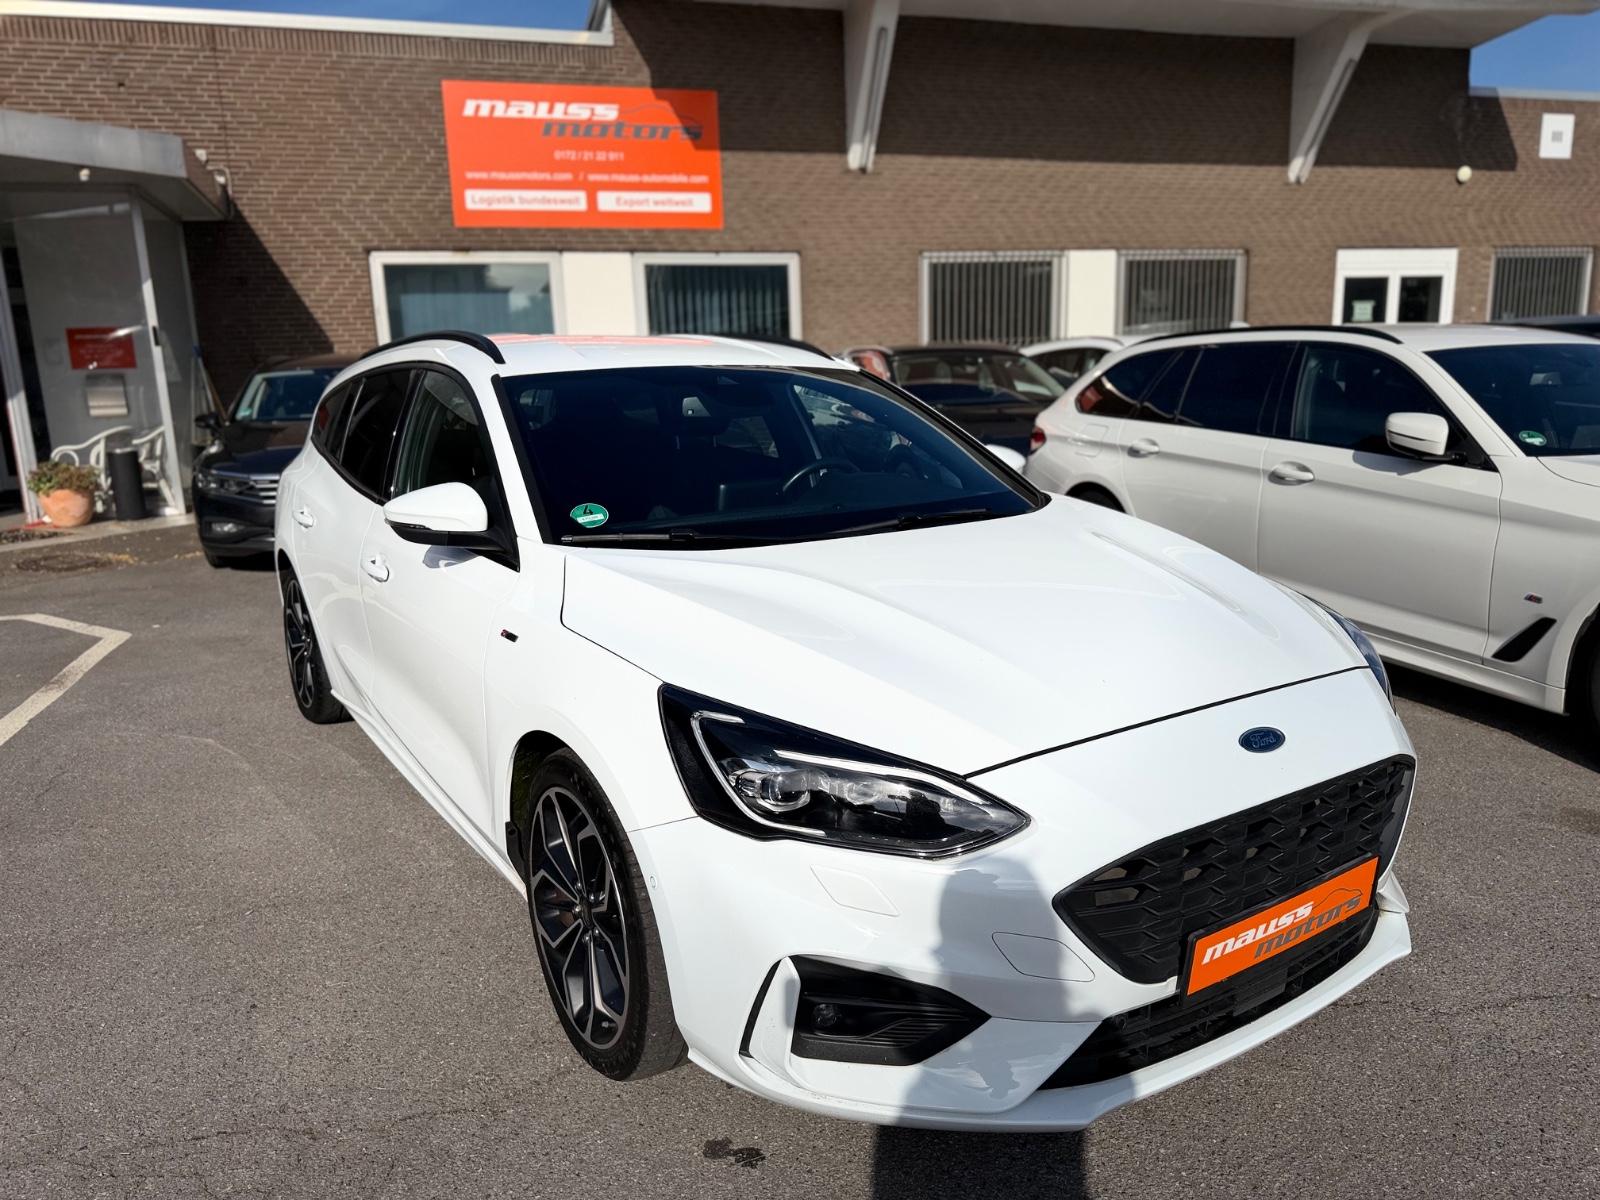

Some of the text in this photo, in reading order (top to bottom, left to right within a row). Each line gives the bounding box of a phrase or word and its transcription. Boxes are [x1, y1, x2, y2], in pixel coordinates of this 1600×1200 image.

[462, 99, 619, 120] mauss
[542, 122, 702, 140] motors
[471, 194, 580, 207] Logistik bundesweit
[615, 195, 650, 208] Export
[1250, 732, 1276, 748] Ford
[1202, 902, 1314, 965] mauss
[1254, 897, 1361, 959] motors
